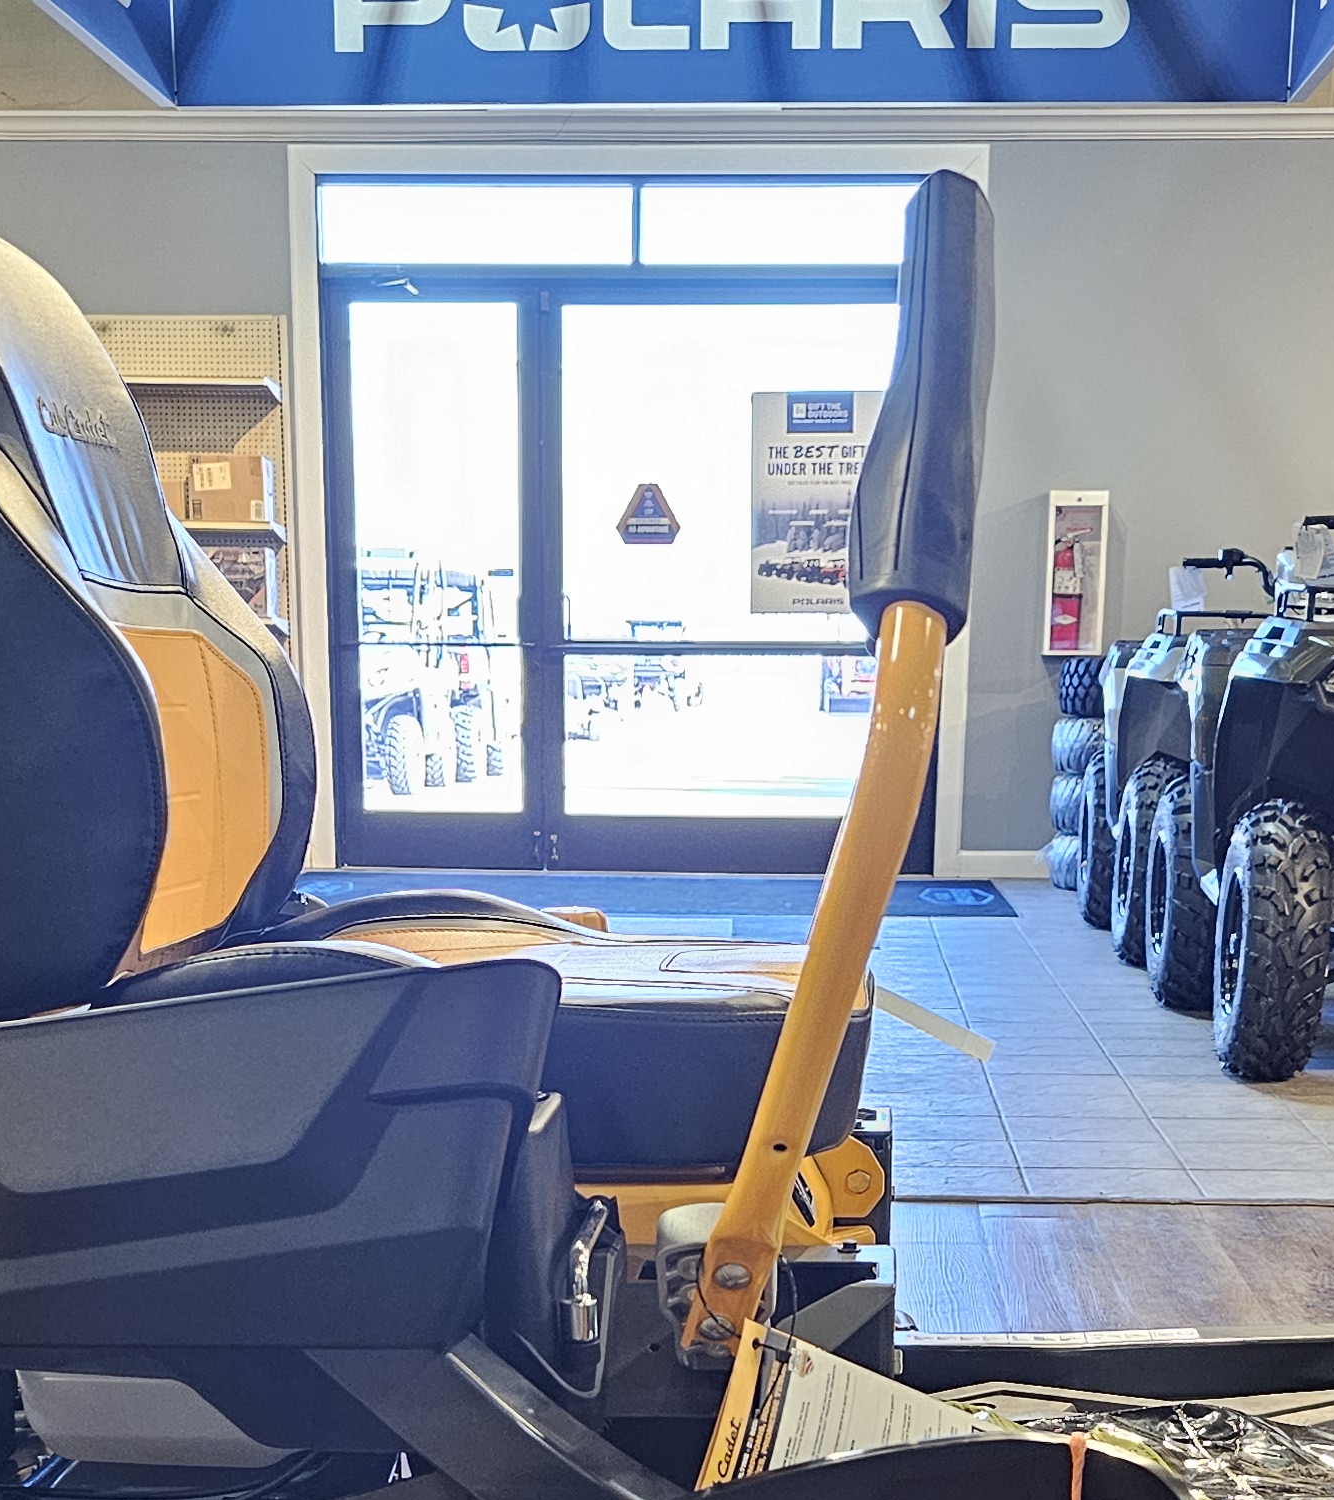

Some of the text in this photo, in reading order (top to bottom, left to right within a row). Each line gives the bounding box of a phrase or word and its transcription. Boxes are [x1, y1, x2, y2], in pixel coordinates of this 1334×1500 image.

[768, 445, 866, 459] THE BEST GIFT
[767, 462, 807, 476] UNDER
[811, 462, 835, 476] THE
[792, 597, 845, 606] POLARIS
[717, 1416, 742, 1478] Cadet
